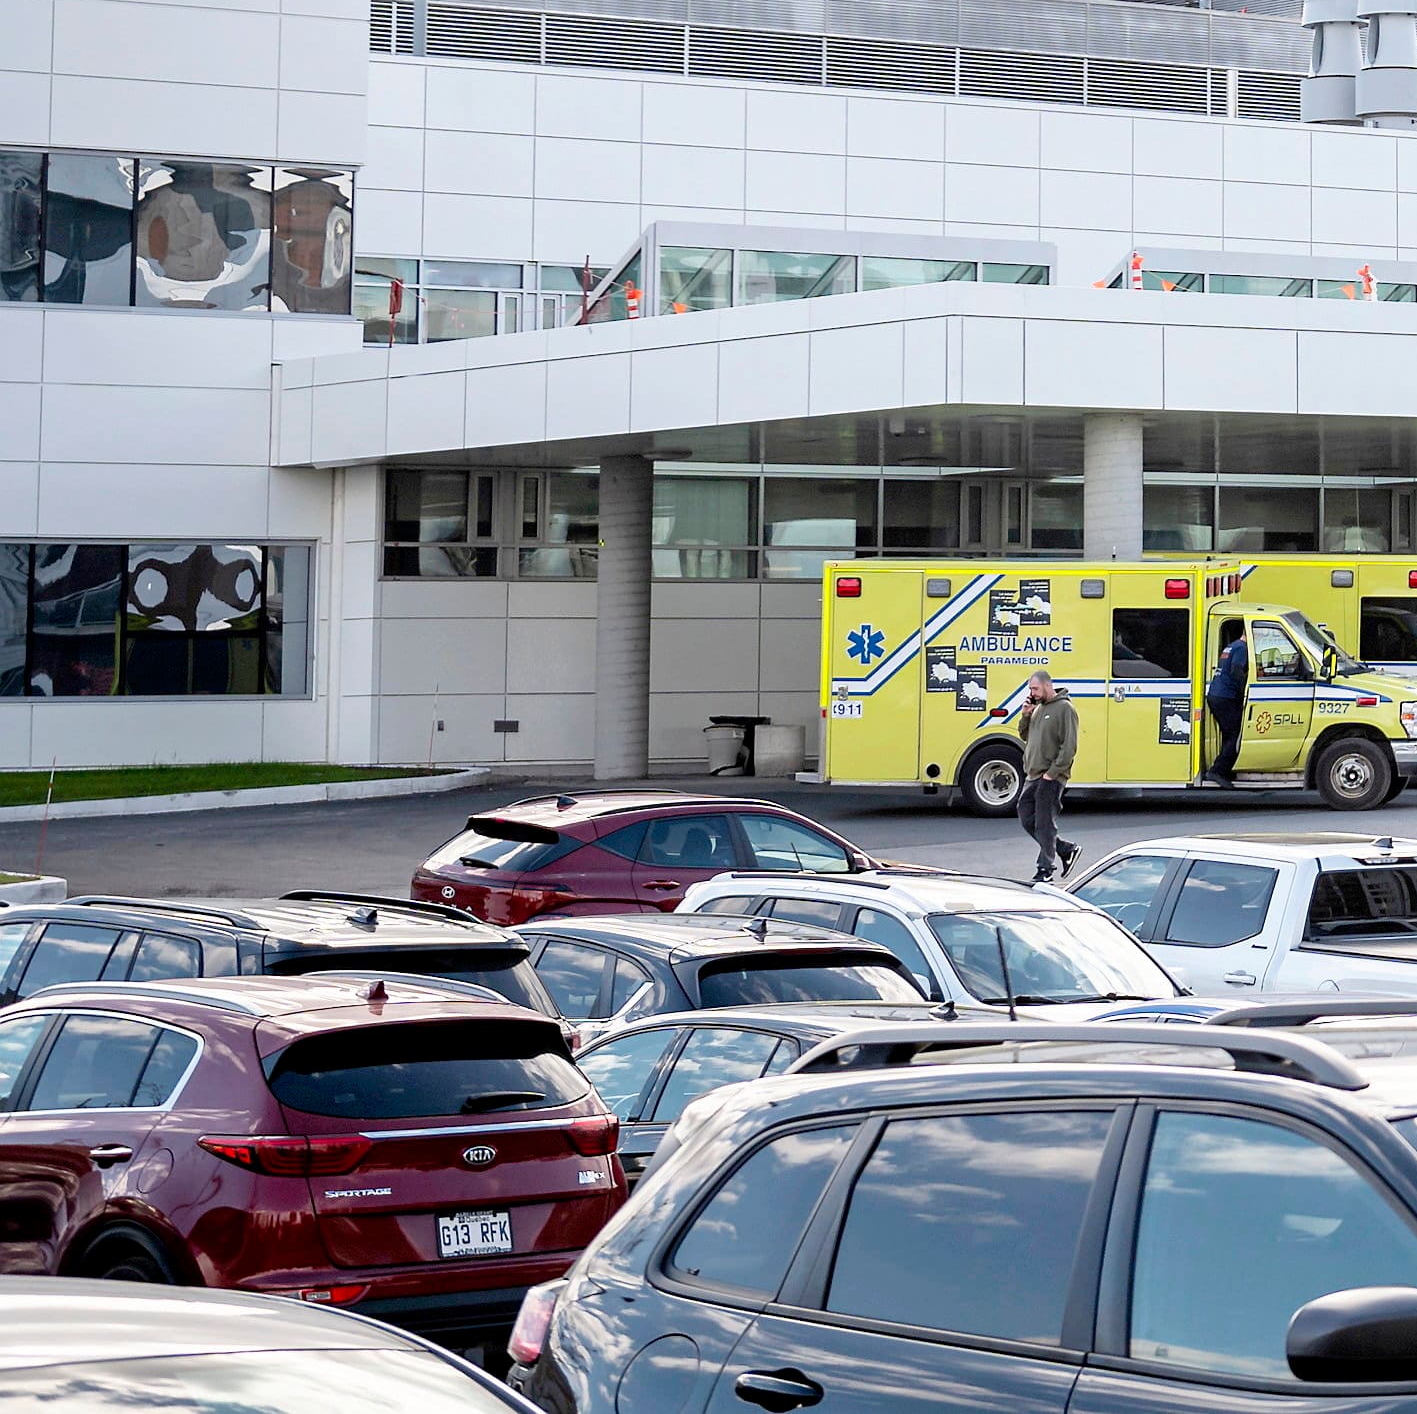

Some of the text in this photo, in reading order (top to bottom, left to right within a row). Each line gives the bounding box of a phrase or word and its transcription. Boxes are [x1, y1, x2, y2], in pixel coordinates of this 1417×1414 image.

[959, 636, 1073, 652] AMBULANCE
[981, 656, 1049, 665] PARAMEDIC
[1319, 702, 1350, 714] 9327
[1273, 714, 1304, 725] SPLL
[469, 1150, 491, 1161] KIA
[325, 1187, 392, 1198] SPORTAGE
[442, 1220, 509, 1246] G13 RFK
